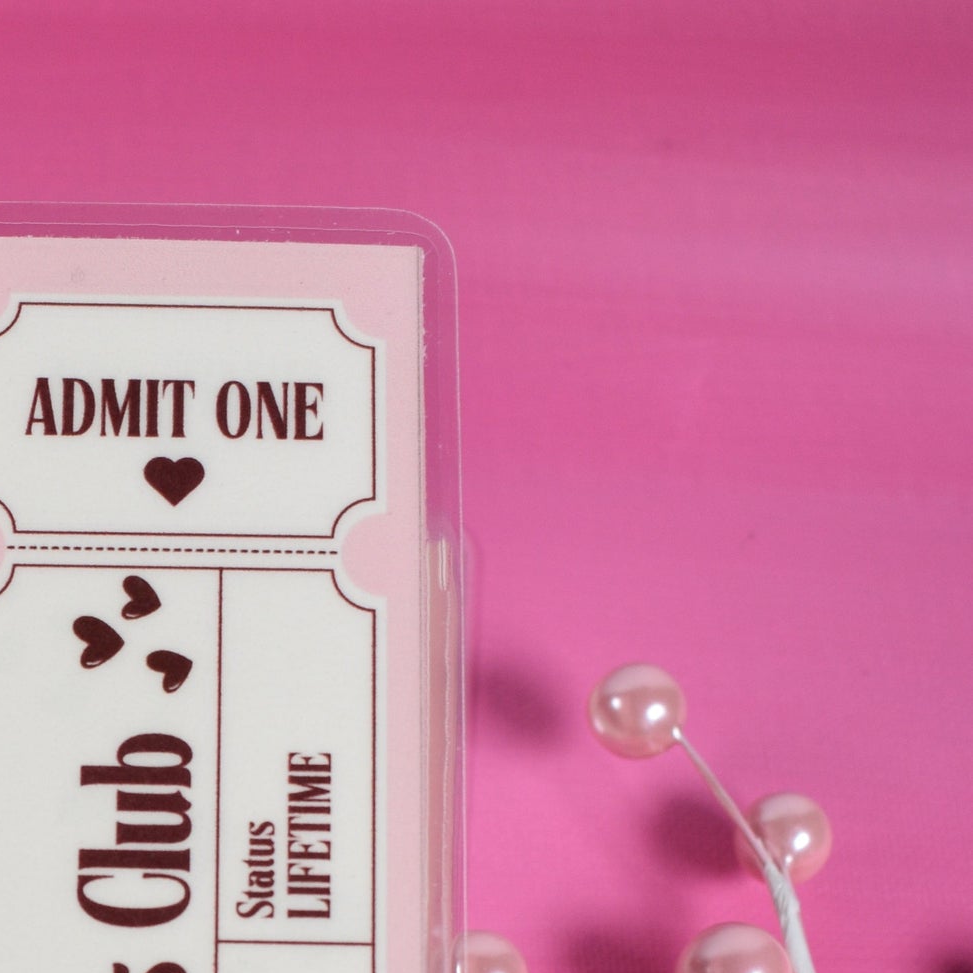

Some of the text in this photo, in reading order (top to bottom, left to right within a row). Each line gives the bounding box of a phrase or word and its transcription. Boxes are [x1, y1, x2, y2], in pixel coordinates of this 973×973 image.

[25, 377, 325, 441] ADMIT ONE
[76, 732, 194, 929] Club
[235, 820, 276, 920] Status
[287, 752, 333, 920] LIFETIME
